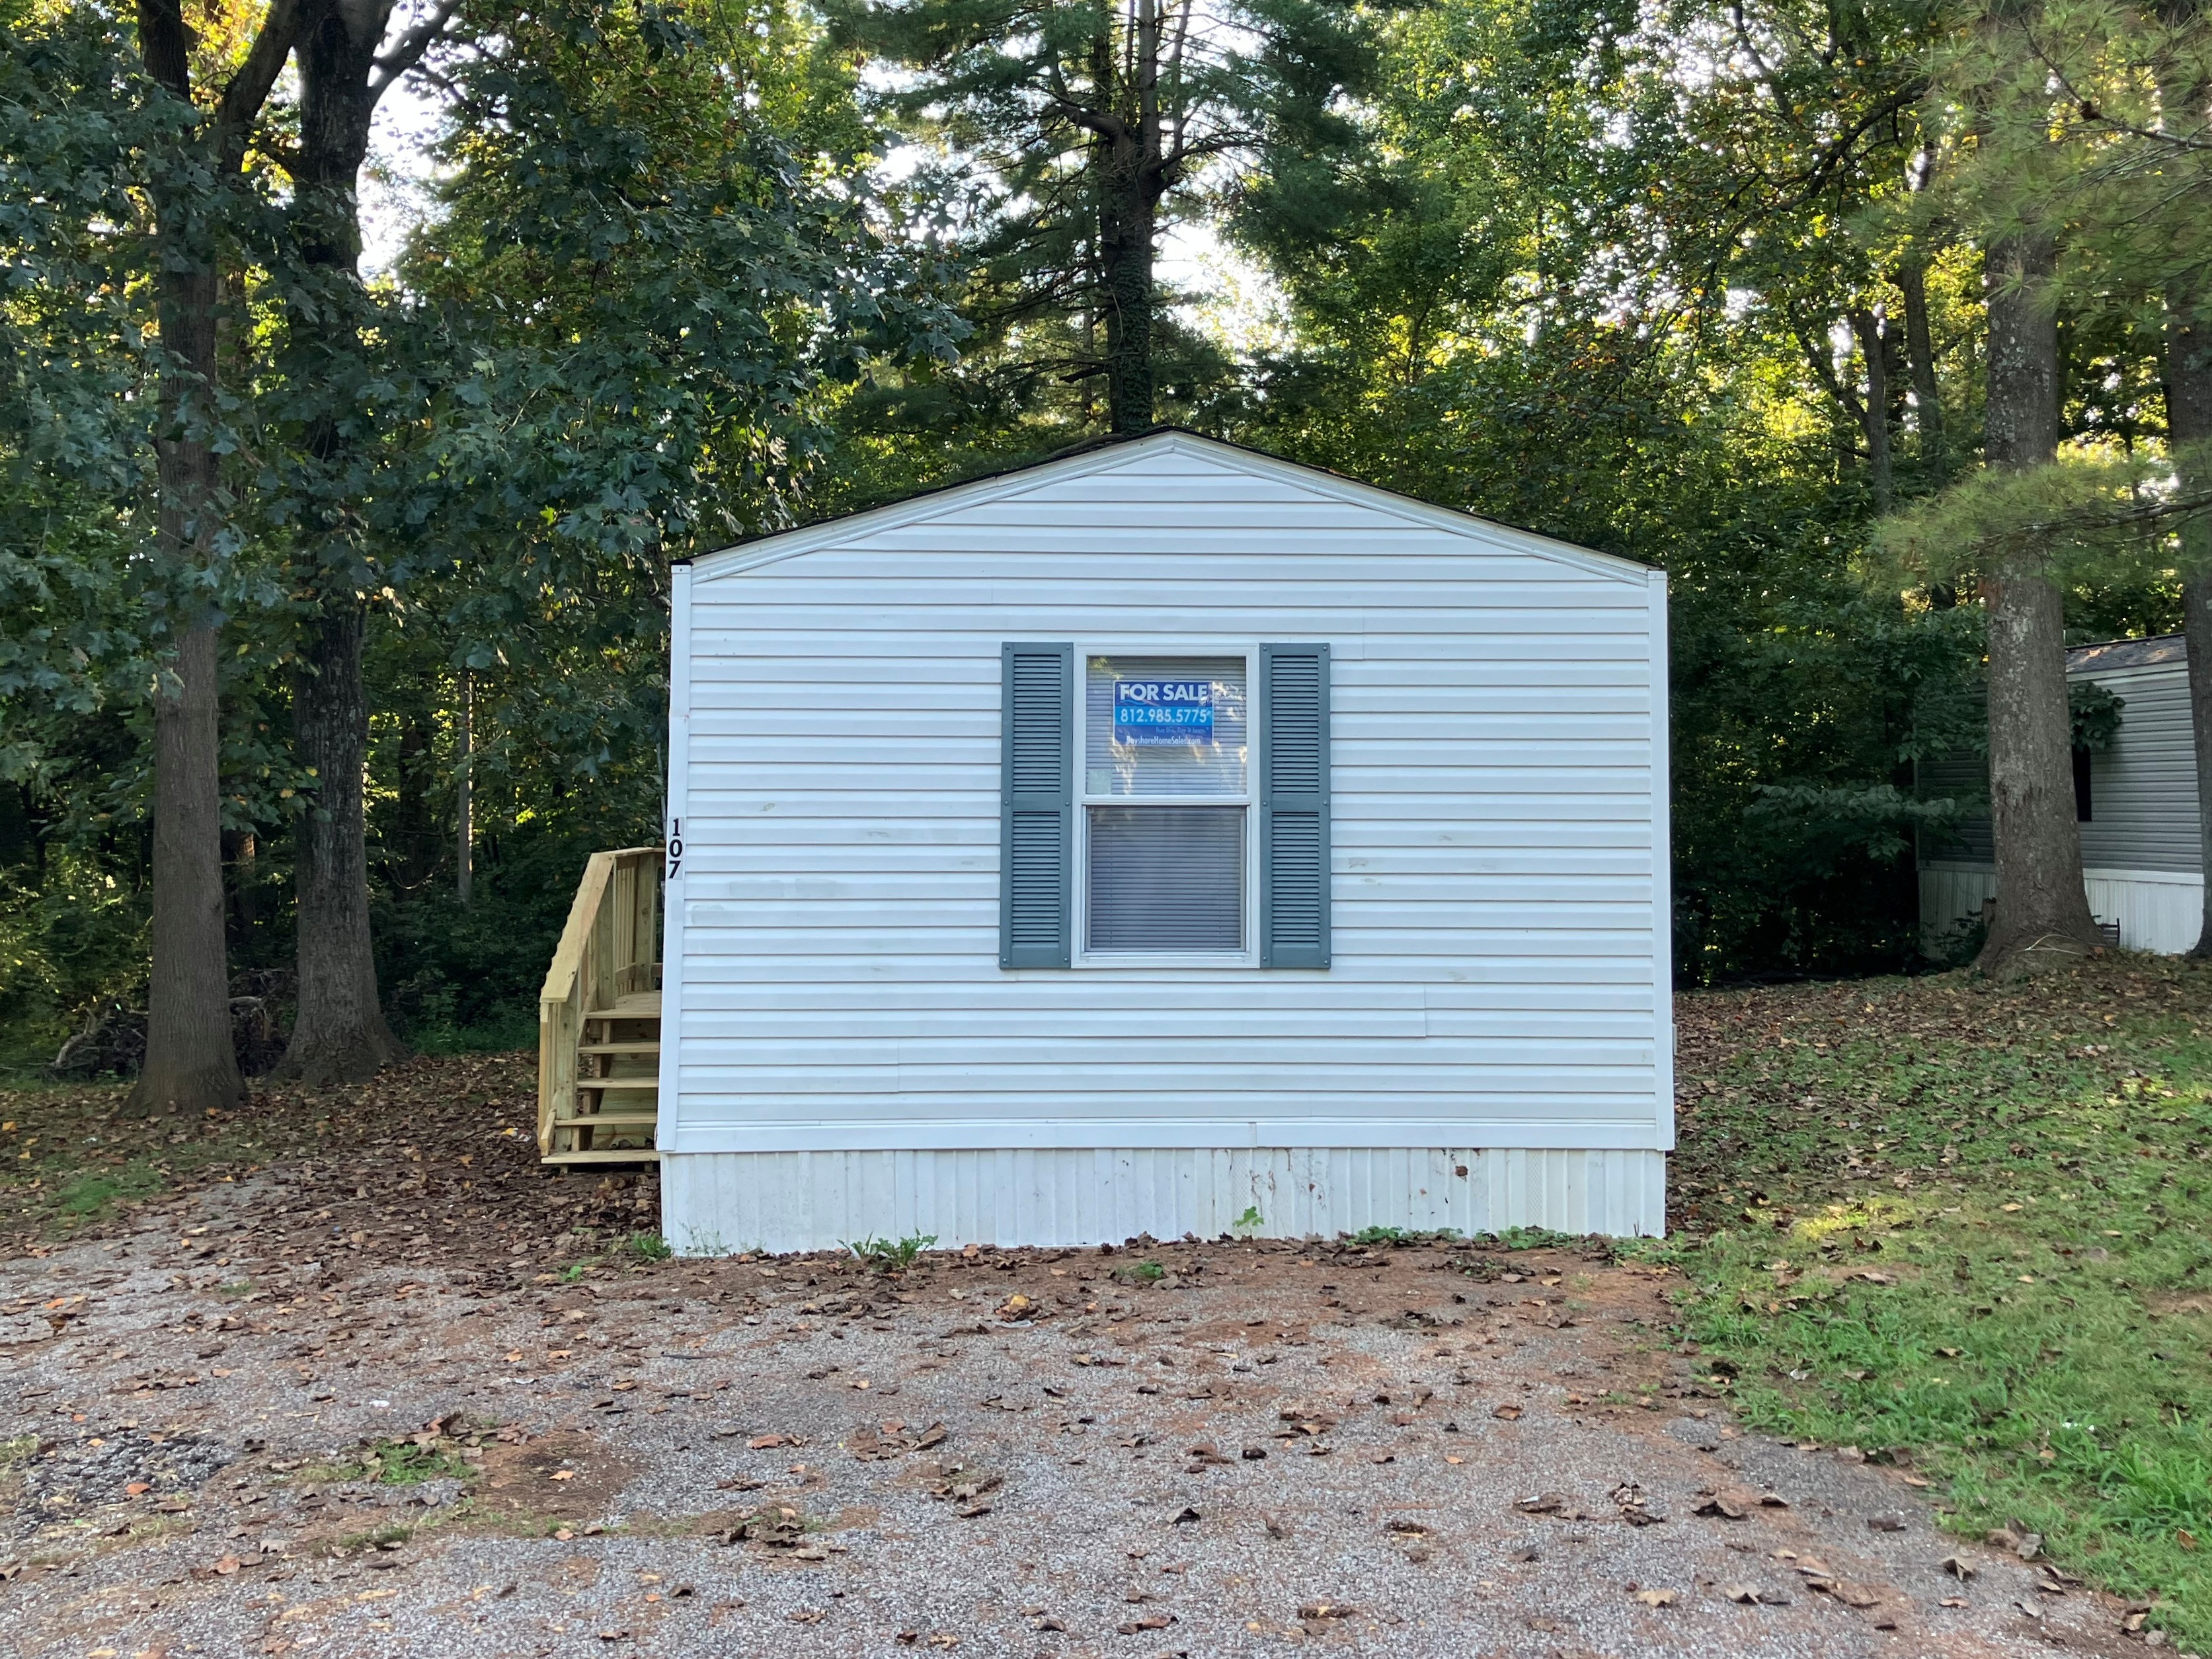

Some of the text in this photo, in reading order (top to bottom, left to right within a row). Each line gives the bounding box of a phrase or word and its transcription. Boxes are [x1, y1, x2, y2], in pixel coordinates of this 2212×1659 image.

[1120, 683, 1208, 701] FOR SALE
[1121, 709, 1207, 723] 812.985.5775
[668, 818, 683, 879] 107
